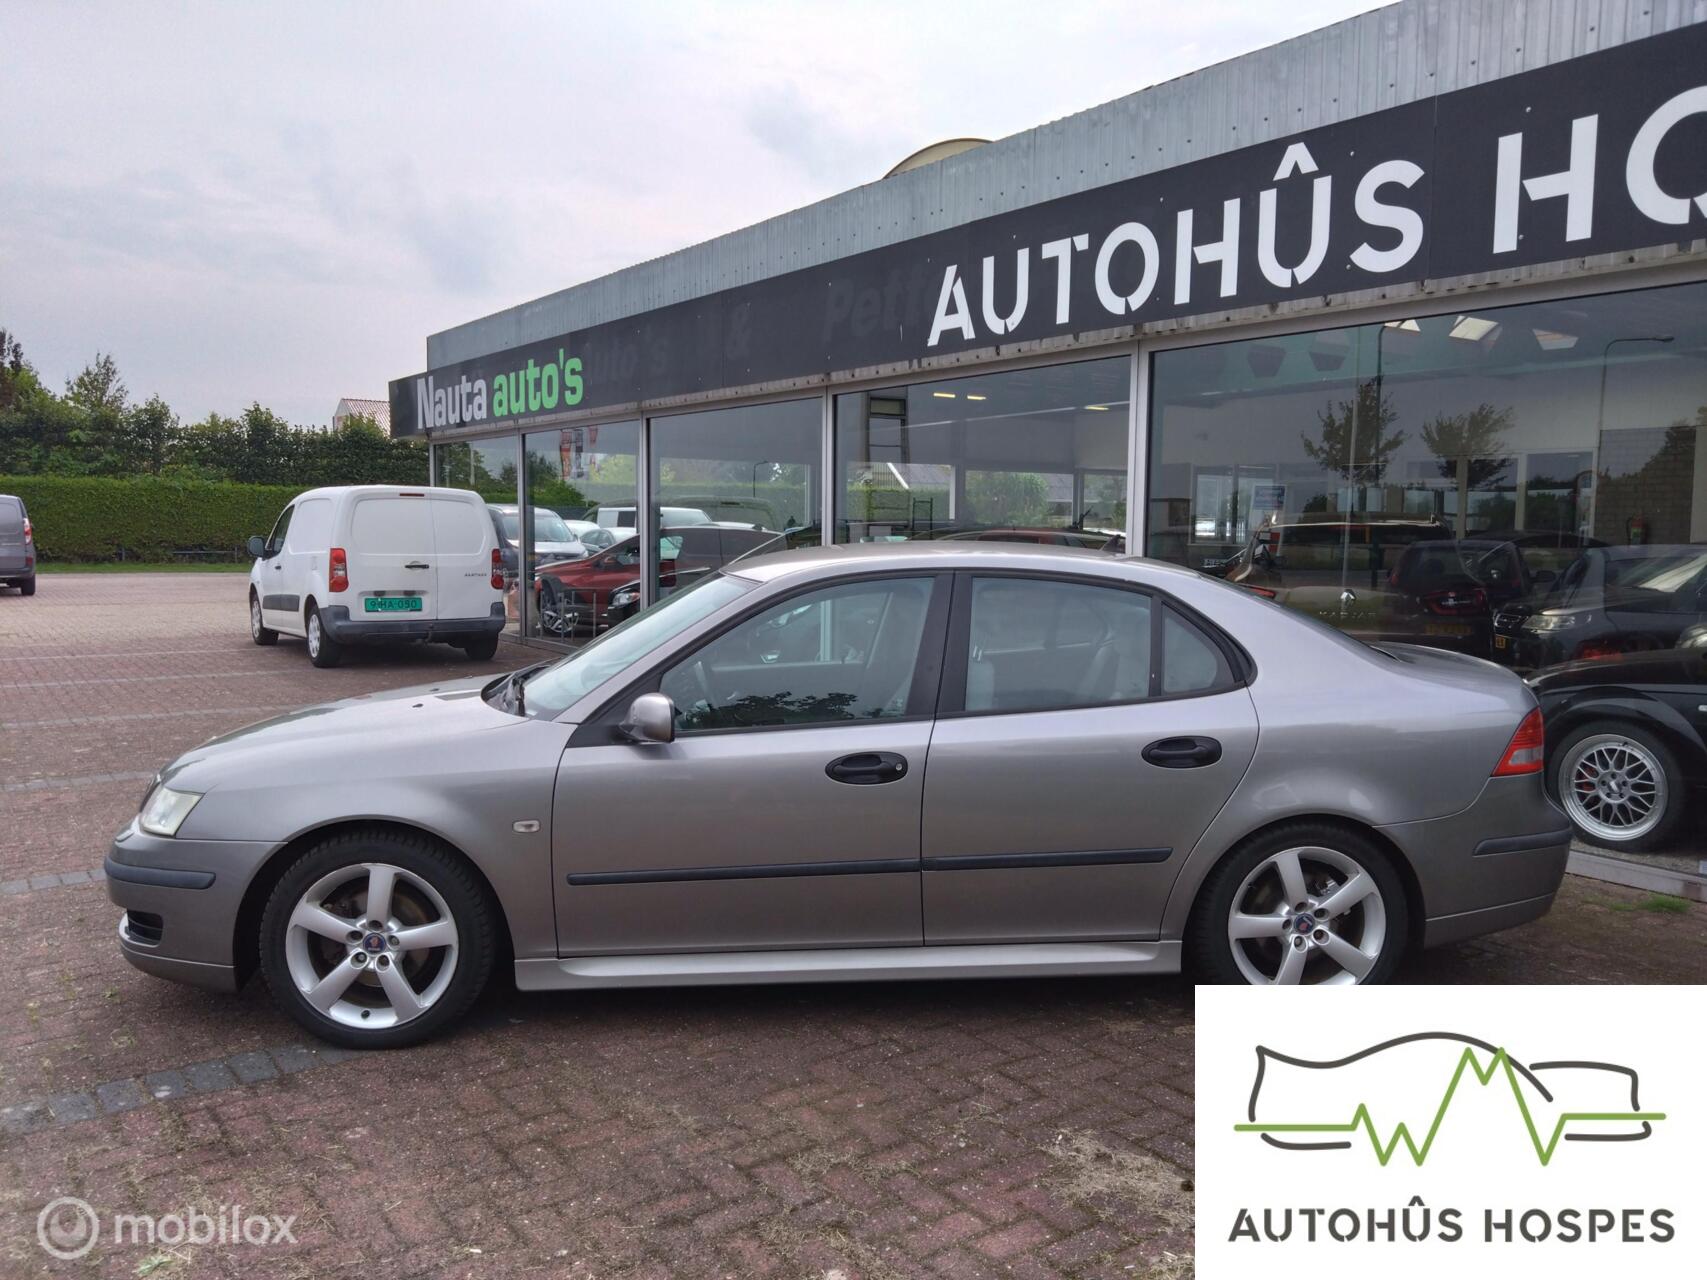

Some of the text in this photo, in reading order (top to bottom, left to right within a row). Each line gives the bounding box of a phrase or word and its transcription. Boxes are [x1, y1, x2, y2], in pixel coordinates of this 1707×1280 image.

[927, 142, 1425, 347] AUTOHÛS
[416, 348, 584, 430] Nauta auto's
